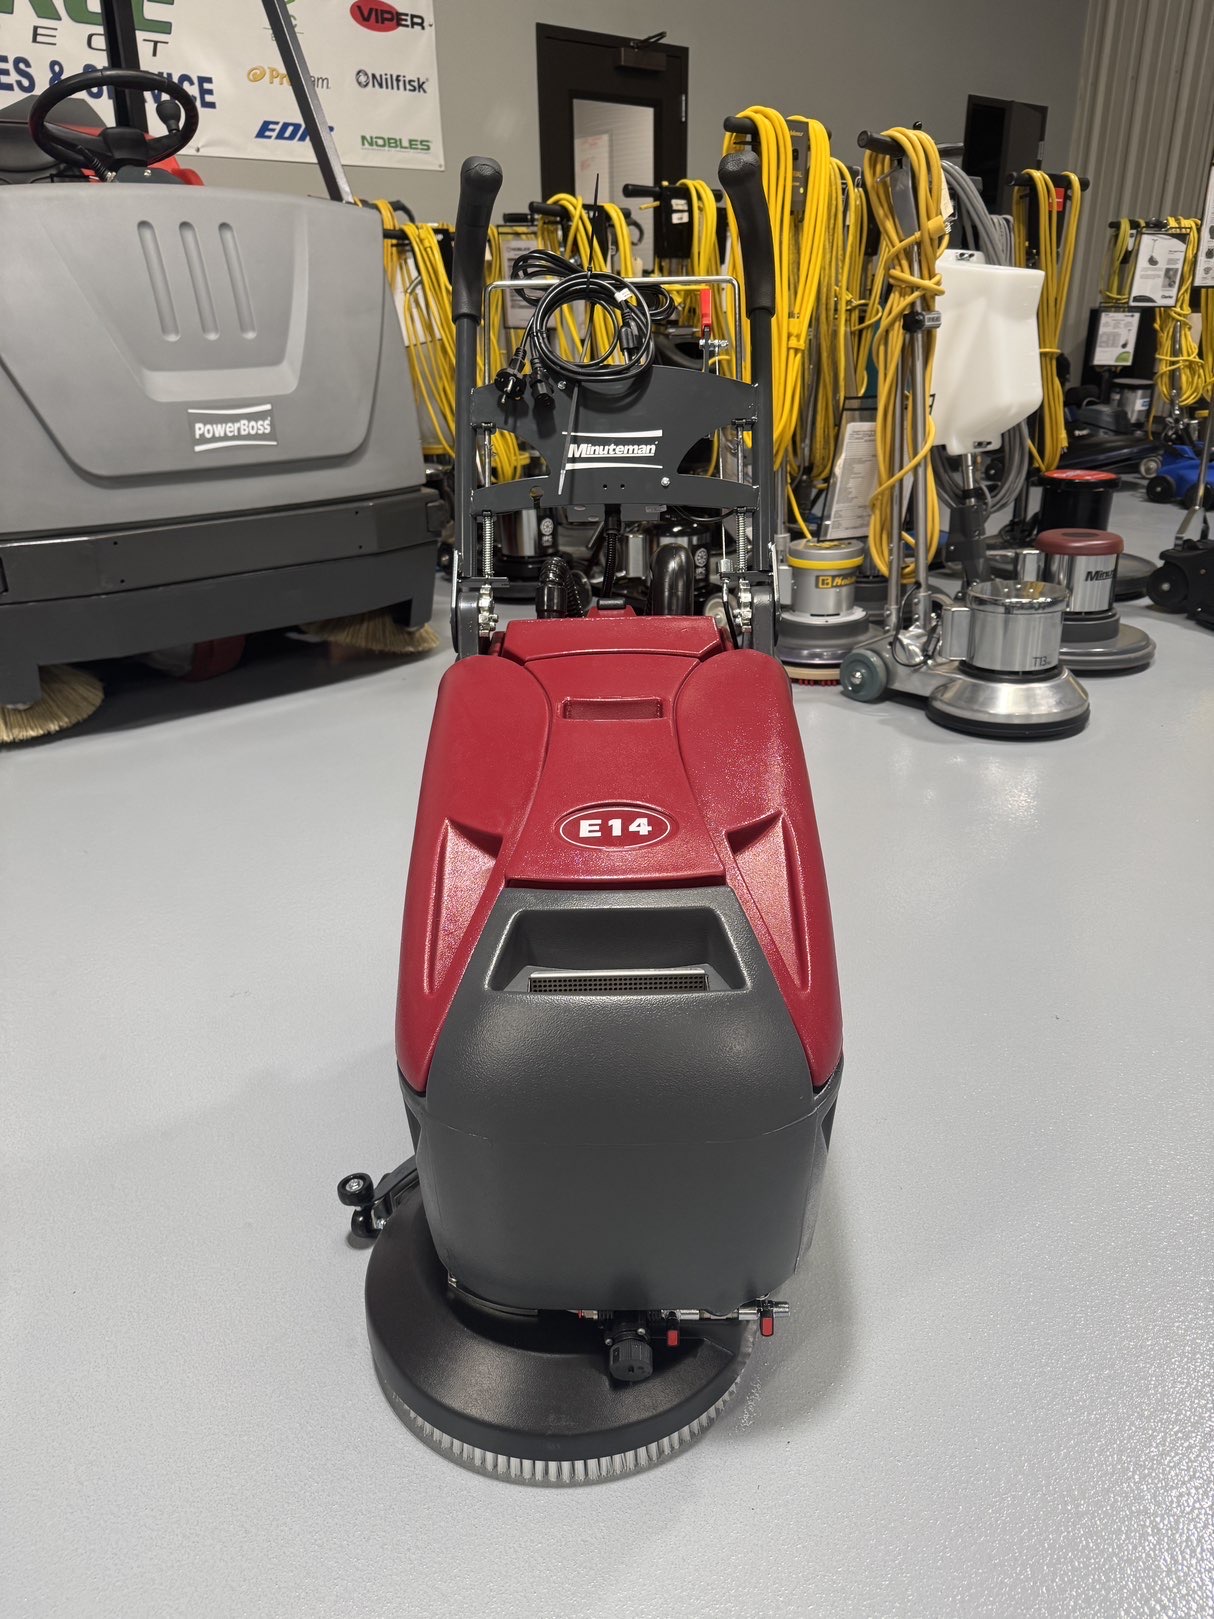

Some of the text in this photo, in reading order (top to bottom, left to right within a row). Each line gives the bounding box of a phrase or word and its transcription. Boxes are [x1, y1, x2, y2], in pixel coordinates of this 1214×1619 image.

[356, 5, 427, 31] VIPER
[371, 72, 427, 94] Nilfisk
[360, 135, 432, 152] NOBLES
[194, 418, 271, 439] PowerBoss
[567, 442, 657, 458] Minuteman
[578, 817, 652, 838] E14
